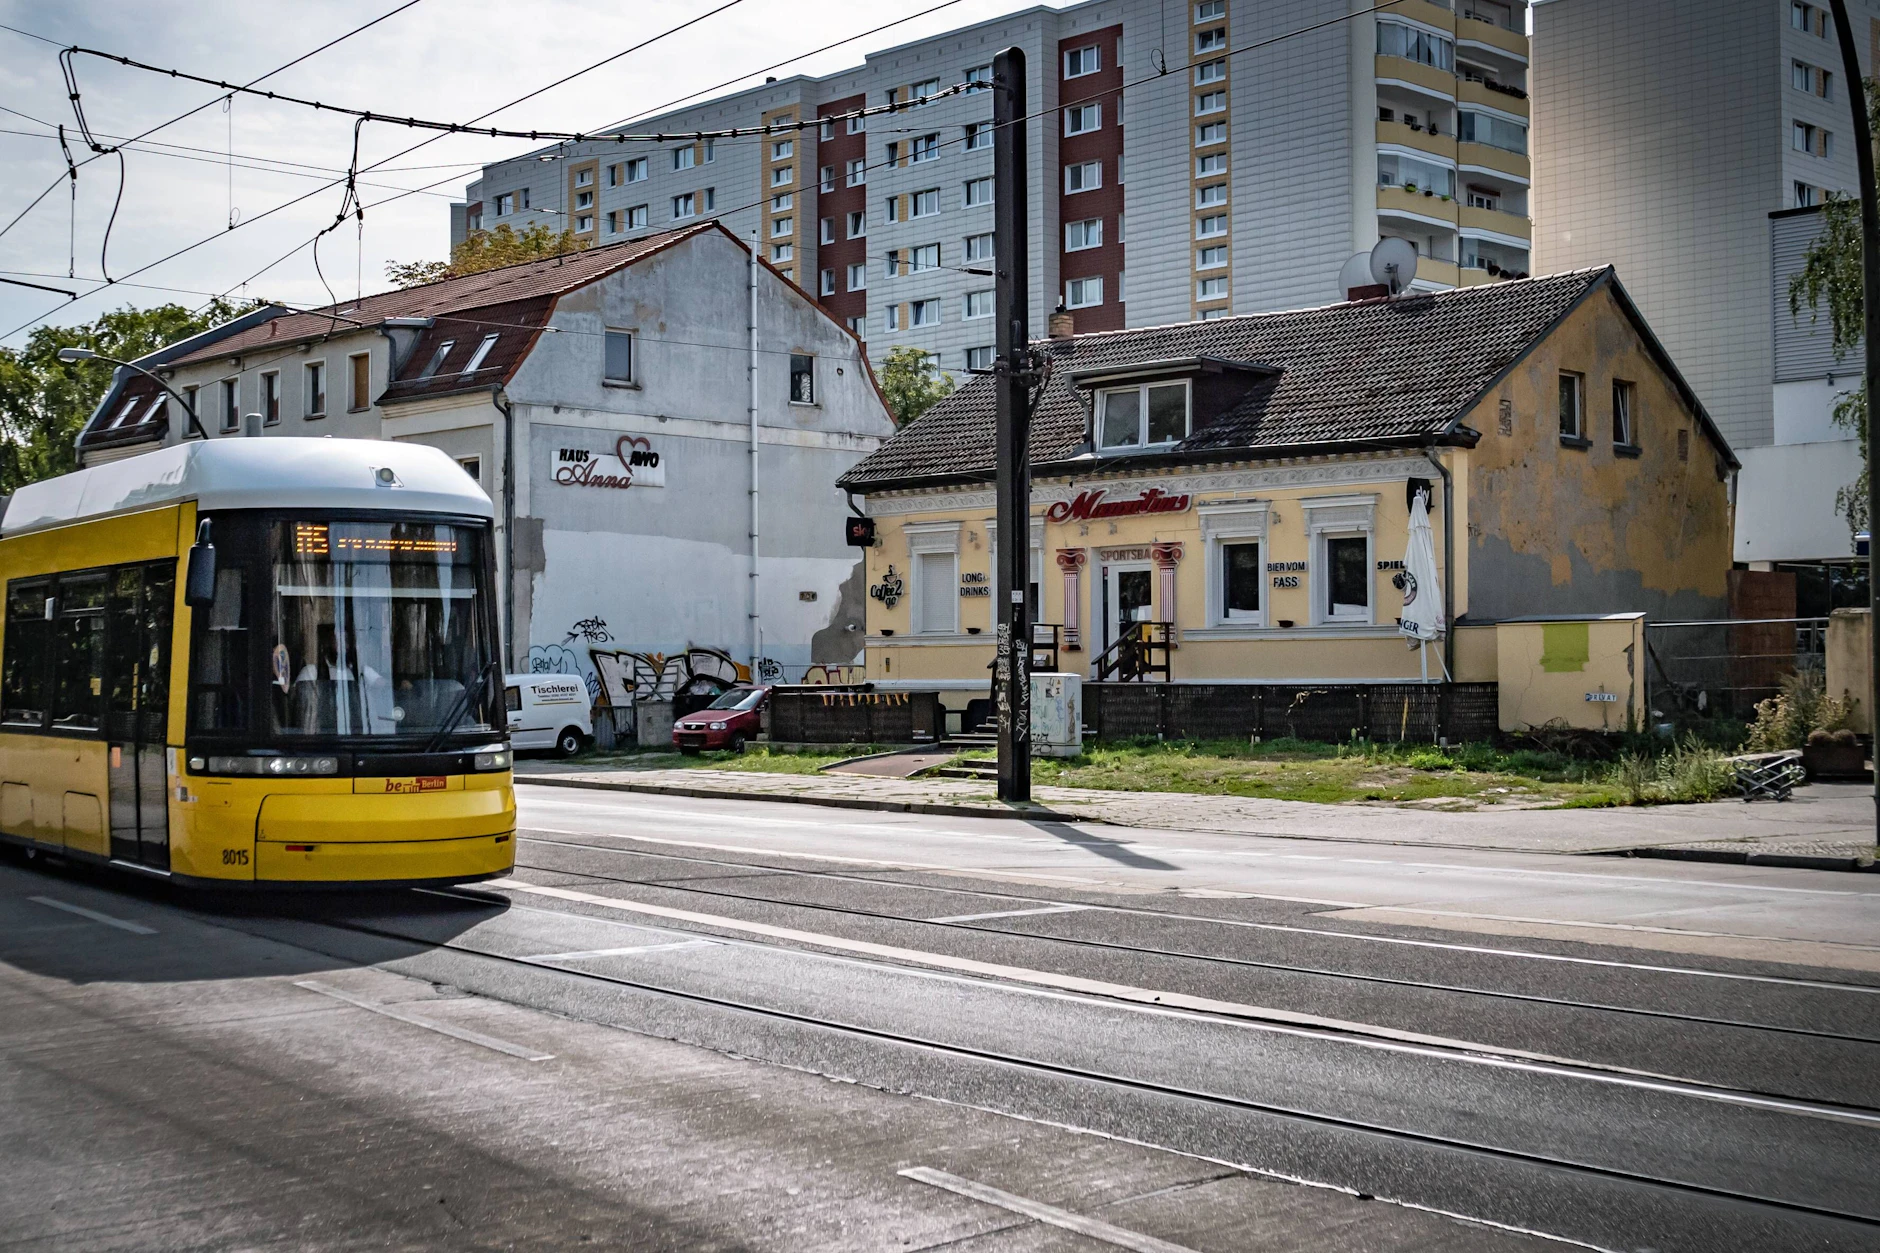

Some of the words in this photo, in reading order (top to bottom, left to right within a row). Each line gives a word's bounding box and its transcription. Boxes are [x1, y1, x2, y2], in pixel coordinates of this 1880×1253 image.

[560, 449, 589, 462] HAUS
[629, 451, 659, 468] AWO
[557, 458, 632, 489] Anna
[1416, 486, 1430, 505] sky
[1101, 548, 1151, 561] SPORTSBA
[1267, 563, 1285, 572] BIER
[1286, 562, 1305, 571] VOM
[1377, 561, 1406, 570] SPIEL
[962, 573, 983, 583] LONG
[1273, 577, 1298, 588] FASS
[871, 584, 895, 601] Coffee
[960, 587, 989, 597] DRINKS
[886, 597, 896, 609] go
[531, 684, 579, 694] Tischlerei
[1586, 693, 1616, 701] PRIVAT
[385, 778, 402, 792] be
[421, 780, 445, 789] Berlin
[222, 849, 249, 866] 8015
